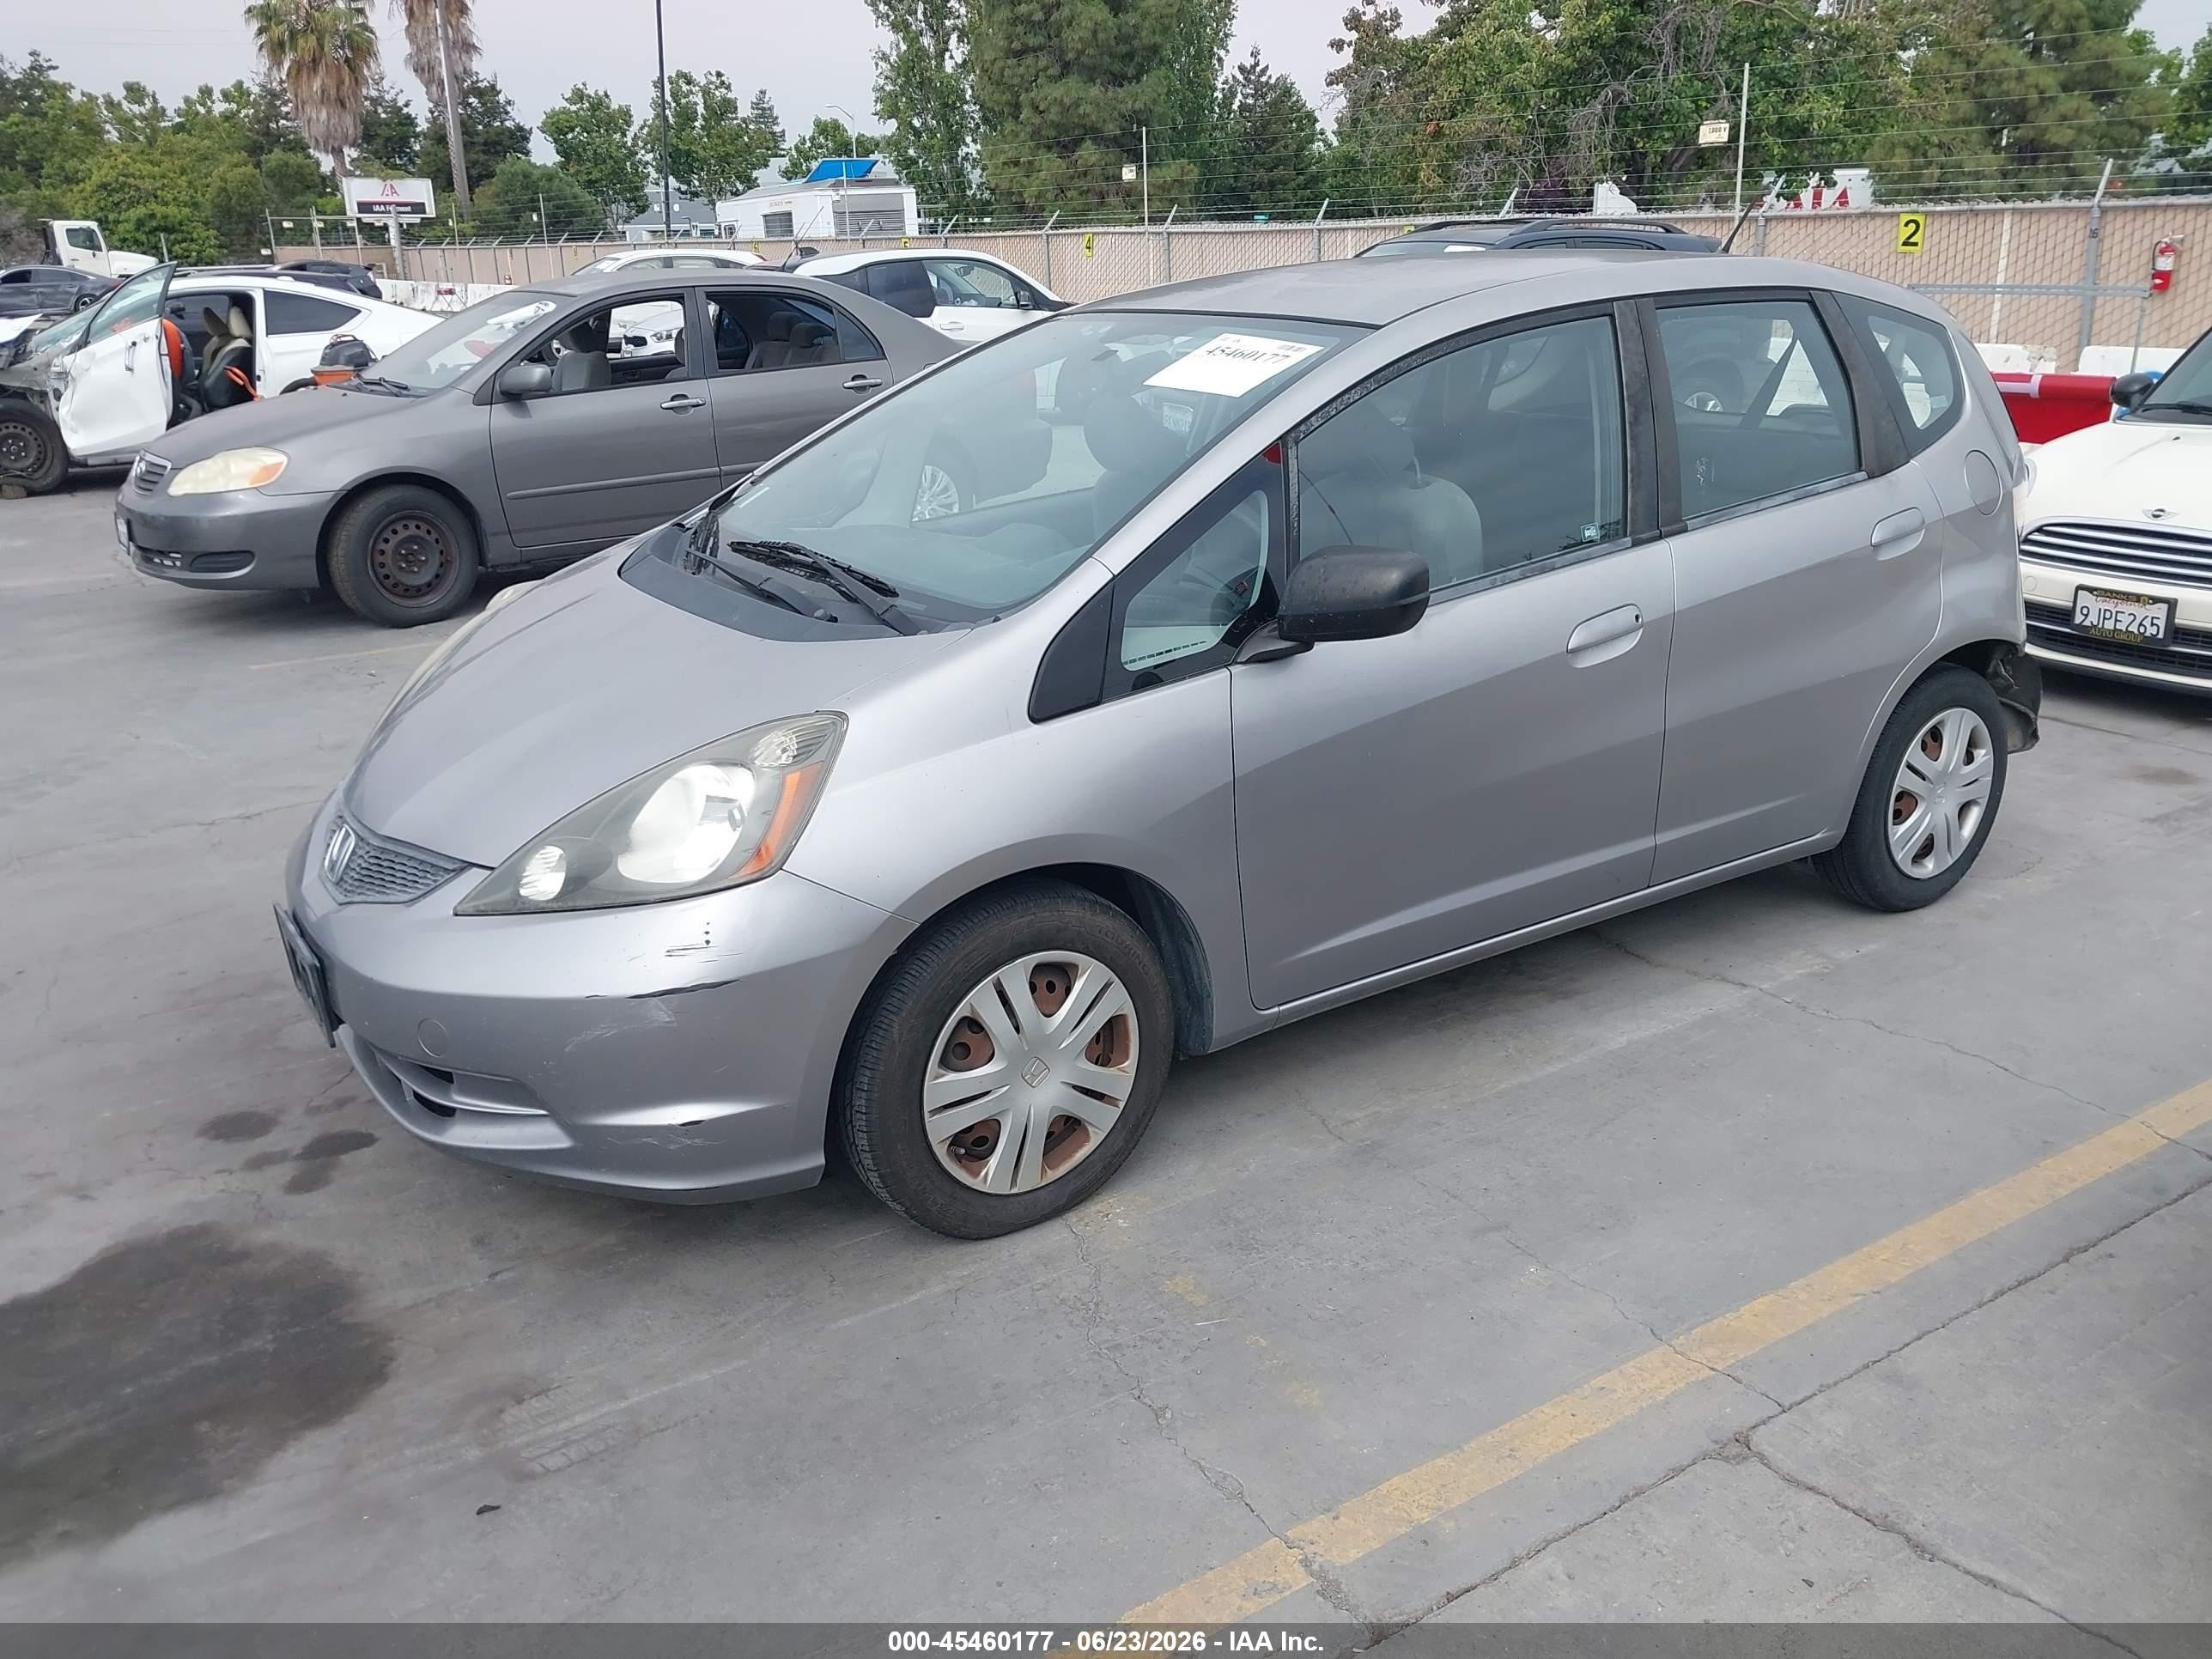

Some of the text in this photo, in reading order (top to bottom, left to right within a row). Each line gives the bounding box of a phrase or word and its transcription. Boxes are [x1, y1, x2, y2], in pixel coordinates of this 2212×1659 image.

[1900, 218, 1922, 247] 2
[1085, 236, 1092, 253] 4
[1206, 345, 1291, 364] 45460177
[2096, 589, 2138, 602] BANKS
[2080, 605, 2161, 637] 9JPE265
[2089, 628, 2143, 643] AUTO GROUP
